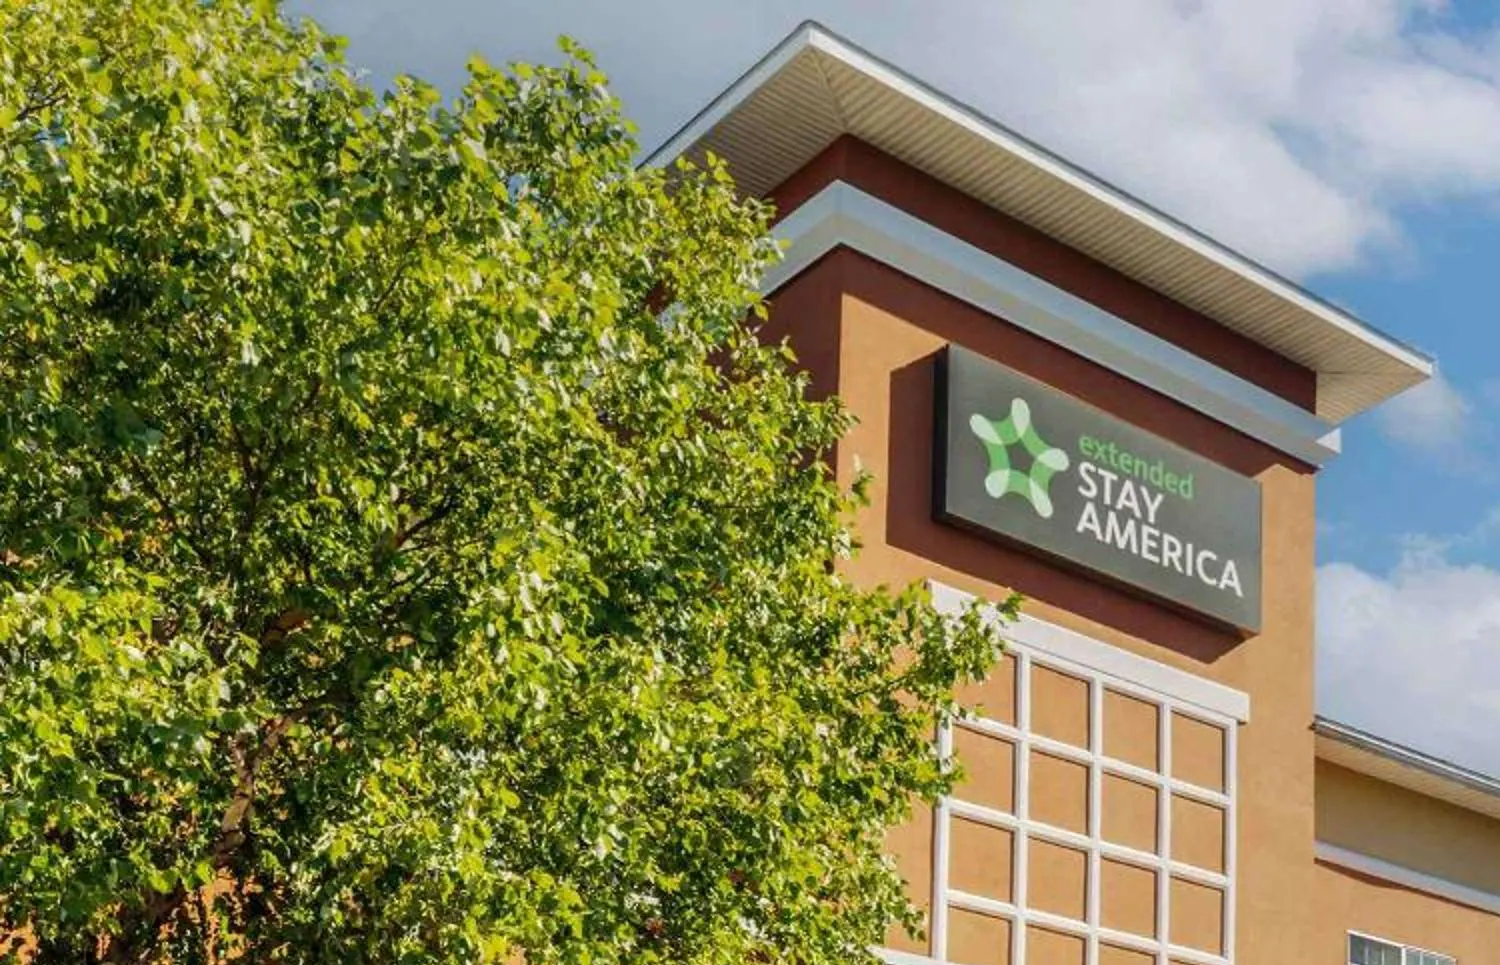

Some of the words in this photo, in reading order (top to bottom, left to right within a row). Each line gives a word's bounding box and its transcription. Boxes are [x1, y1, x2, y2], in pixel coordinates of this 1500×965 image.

[1078, 435, 1193, 499] extended
[1078, 461, 1164, 525] STAY
[1076, 501, 1243, 597] AMERICA
